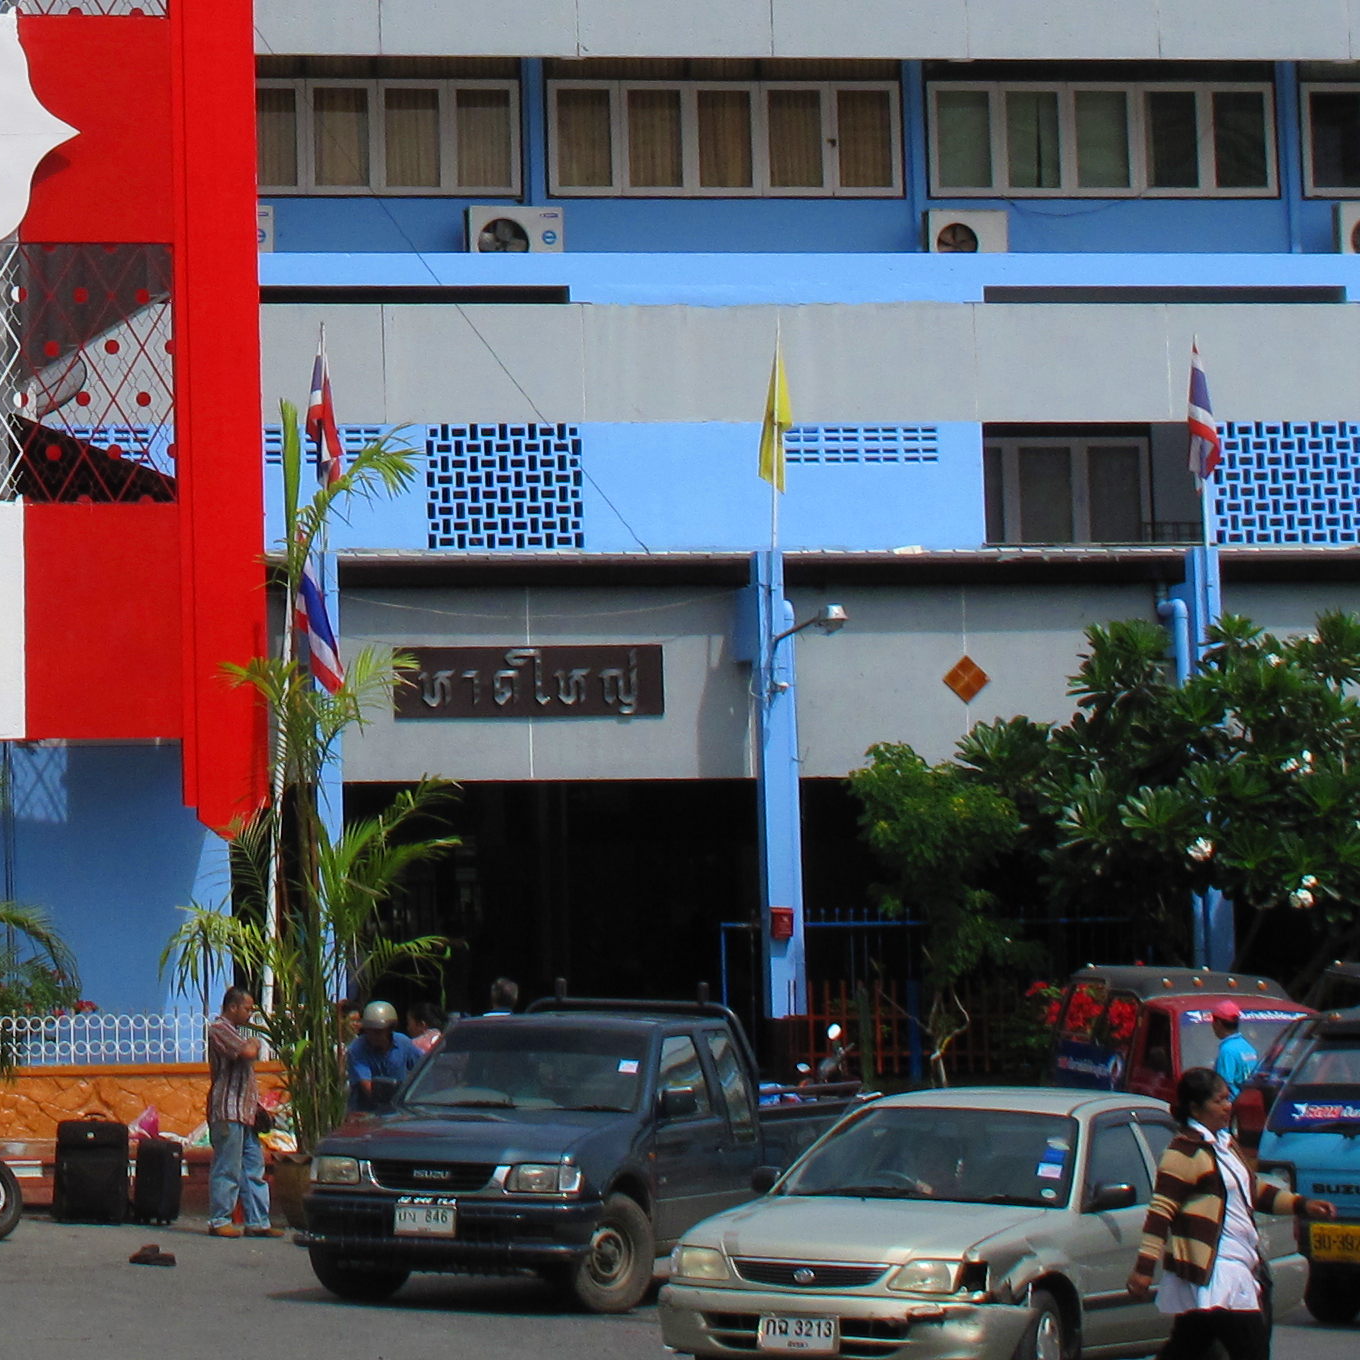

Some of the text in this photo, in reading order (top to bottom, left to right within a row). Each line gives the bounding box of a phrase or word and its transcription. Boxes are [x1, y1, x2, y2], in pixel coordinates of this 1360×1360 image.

[417, 648, 639, 715] หาดใหญ่
[425, 1209, 448, 1223] 846
[794, 1320, 832, 1338] 3213
